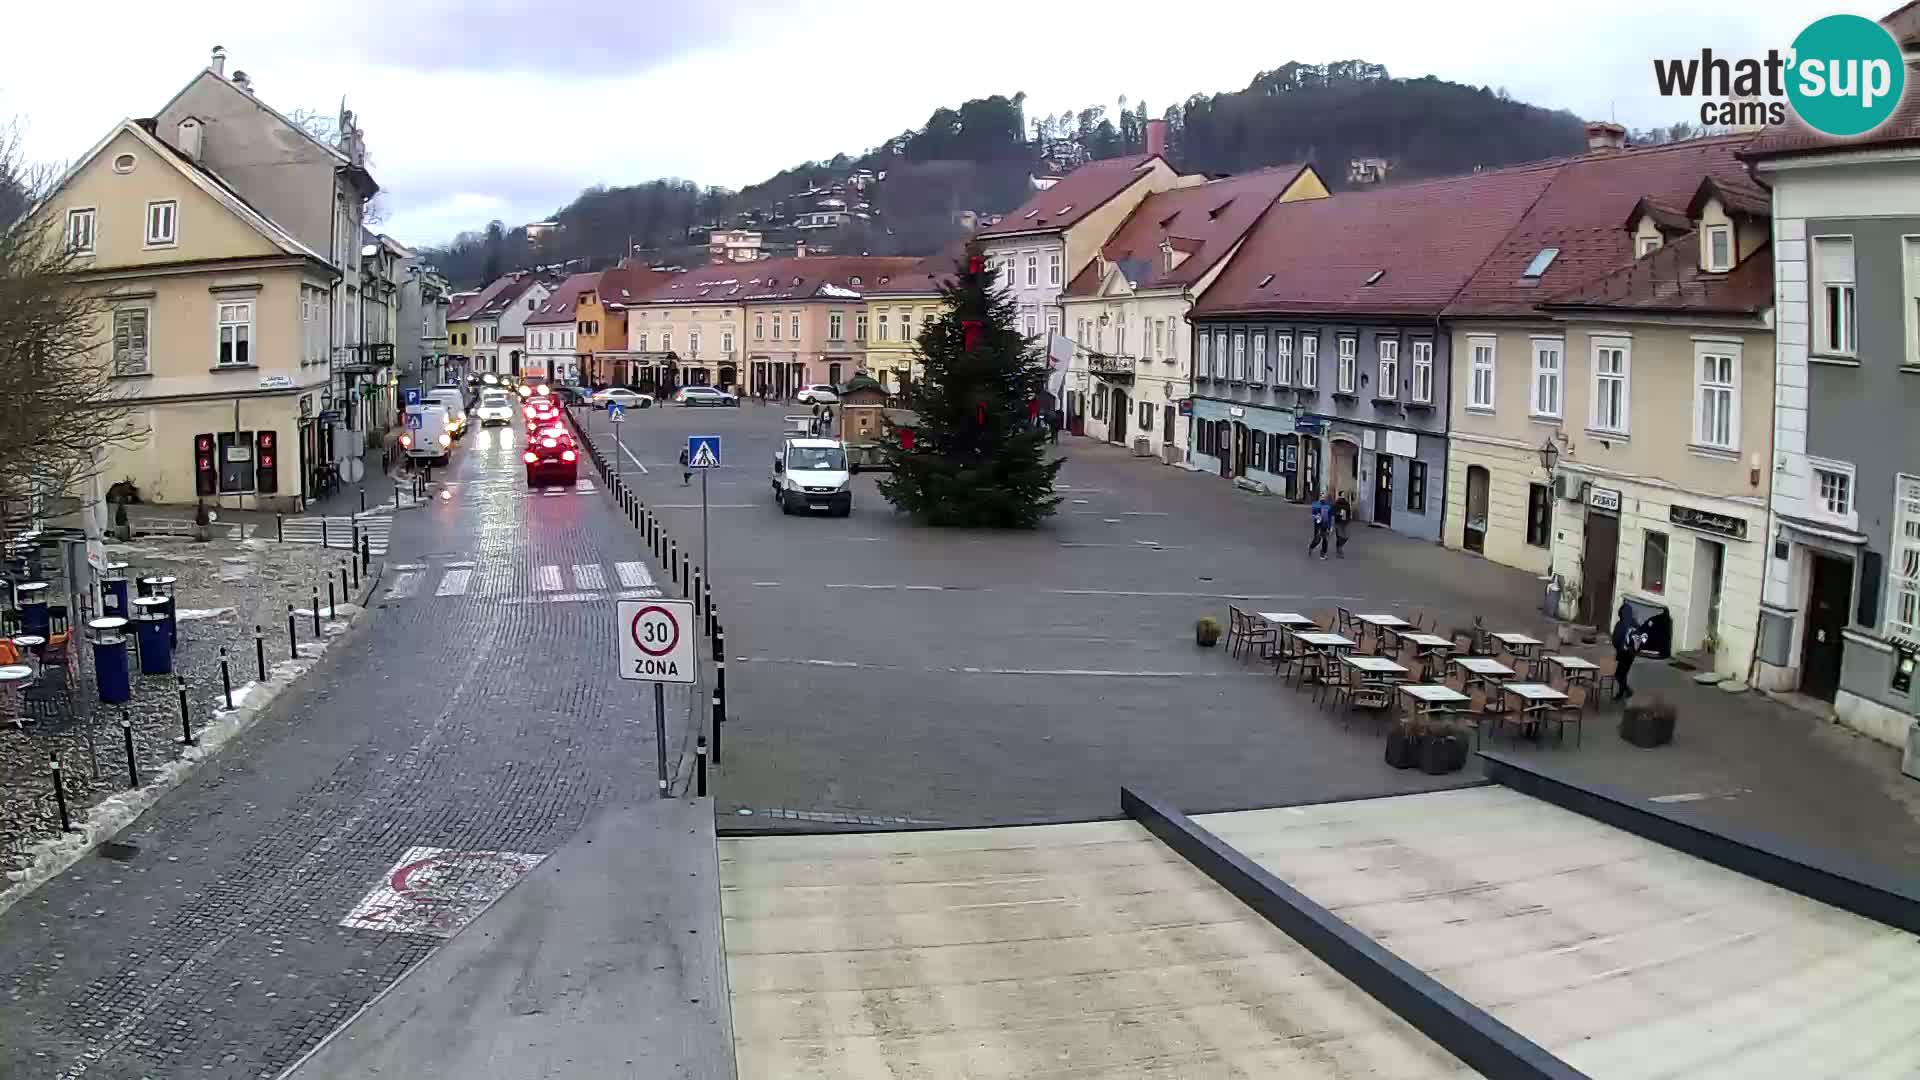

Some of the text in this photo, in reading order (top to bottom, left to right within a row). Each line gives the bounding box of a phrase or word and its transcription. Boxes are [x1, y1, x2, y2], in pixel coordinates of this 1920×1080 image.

[408, 391, 417, 402] P
[644, 621, 668, 643] 30
[634, 659, 679, 676] ZONA
